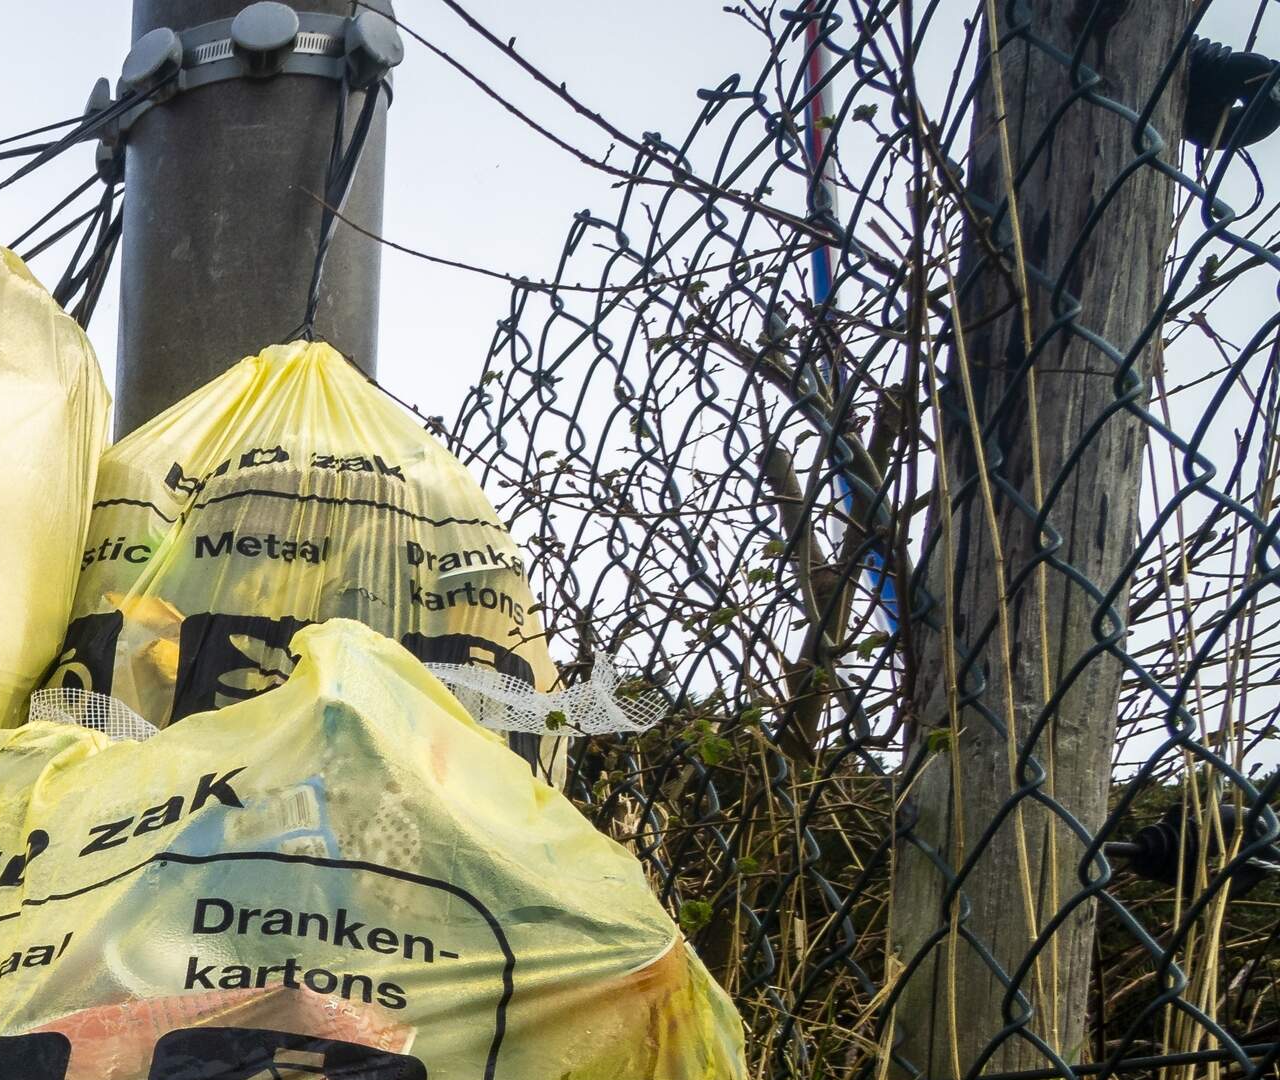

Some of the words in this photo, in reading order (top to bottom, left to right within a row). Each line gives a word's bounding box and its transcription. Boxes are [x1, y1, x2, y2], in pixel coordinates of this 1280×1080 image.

[195, 531, 330, 564] Metaal
[409, 580, 525, 626] kartons
[192, 897, 460, 963] Dranken-
[184, 956, 407, 1010] kartons
